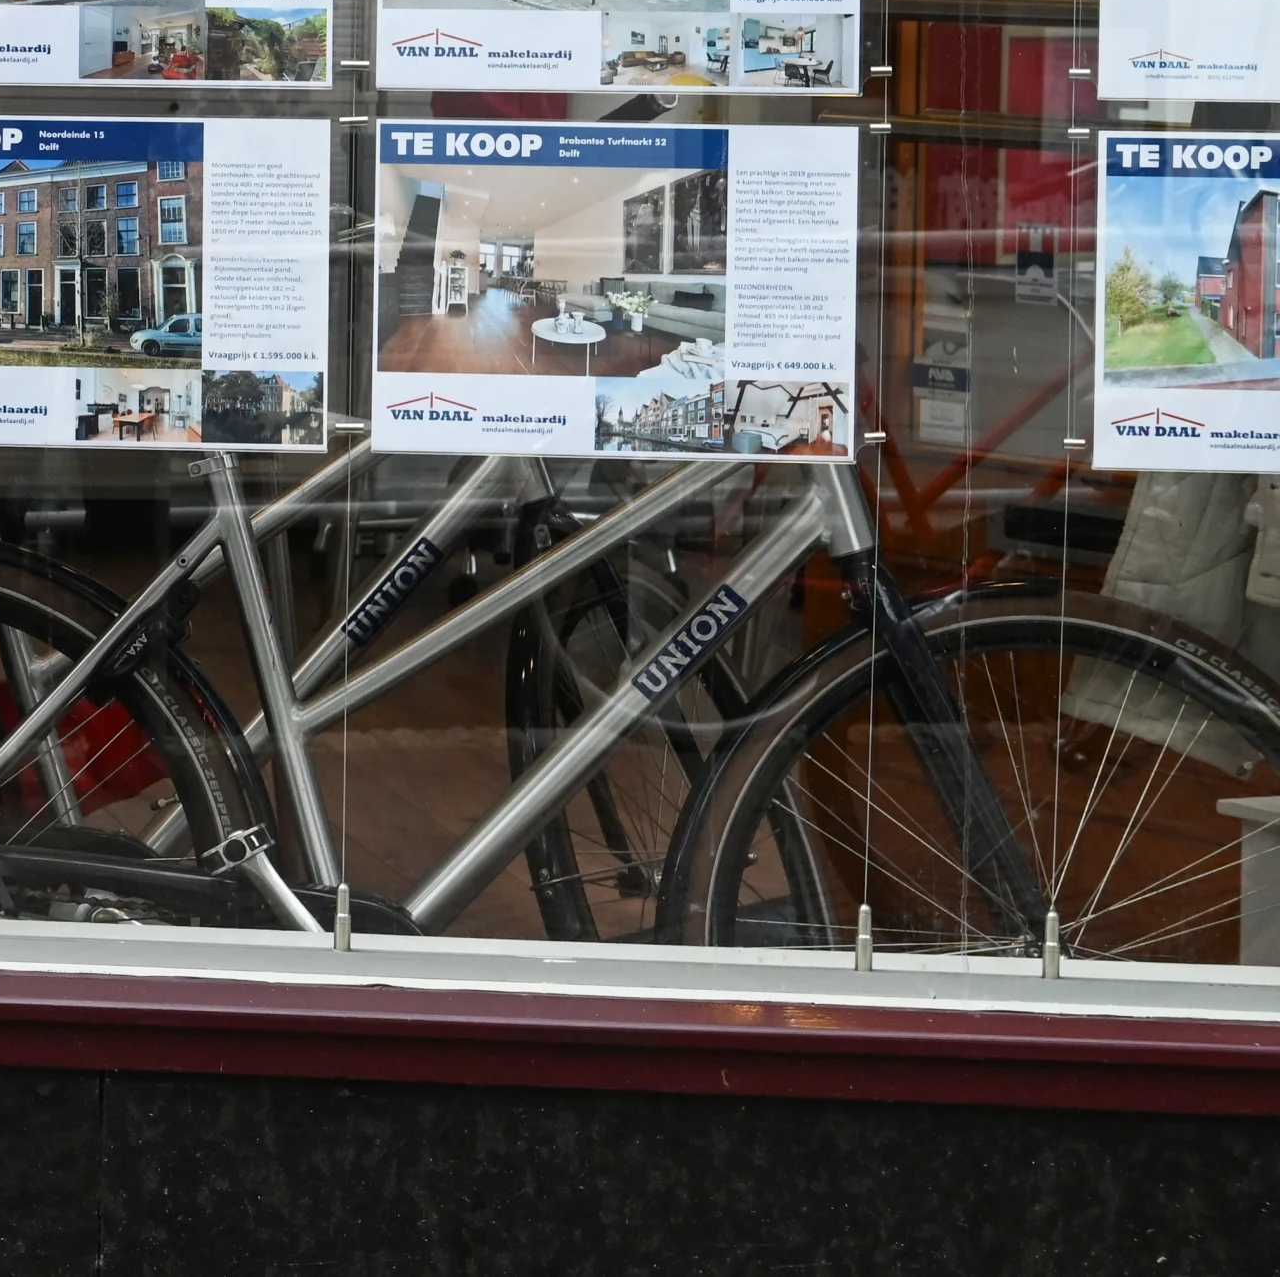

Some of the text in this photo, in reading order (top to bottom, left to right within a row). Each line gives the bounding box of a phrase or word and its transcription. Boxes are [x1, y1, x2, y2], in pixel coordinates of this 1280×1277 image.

[39, 131, 105, 140] Noordeinde 15
[39, 143, 59, 151] Delft
[559, 137, 666, 147] Brabantse Turfmarkt 52
[559, 149, 580, 158] Delft
[1116, 144, 1272, 169] TE KOOP
[209, 351, 250, 361] Vraagprijs
[260, 352, 301, 360] 1.595.000
[304, 352, 318, 361] k.k.
[346, 542, 439, 644] UNION
[127, 633, 148, 656] AXA
[637, 589, 739, 694] UNION
